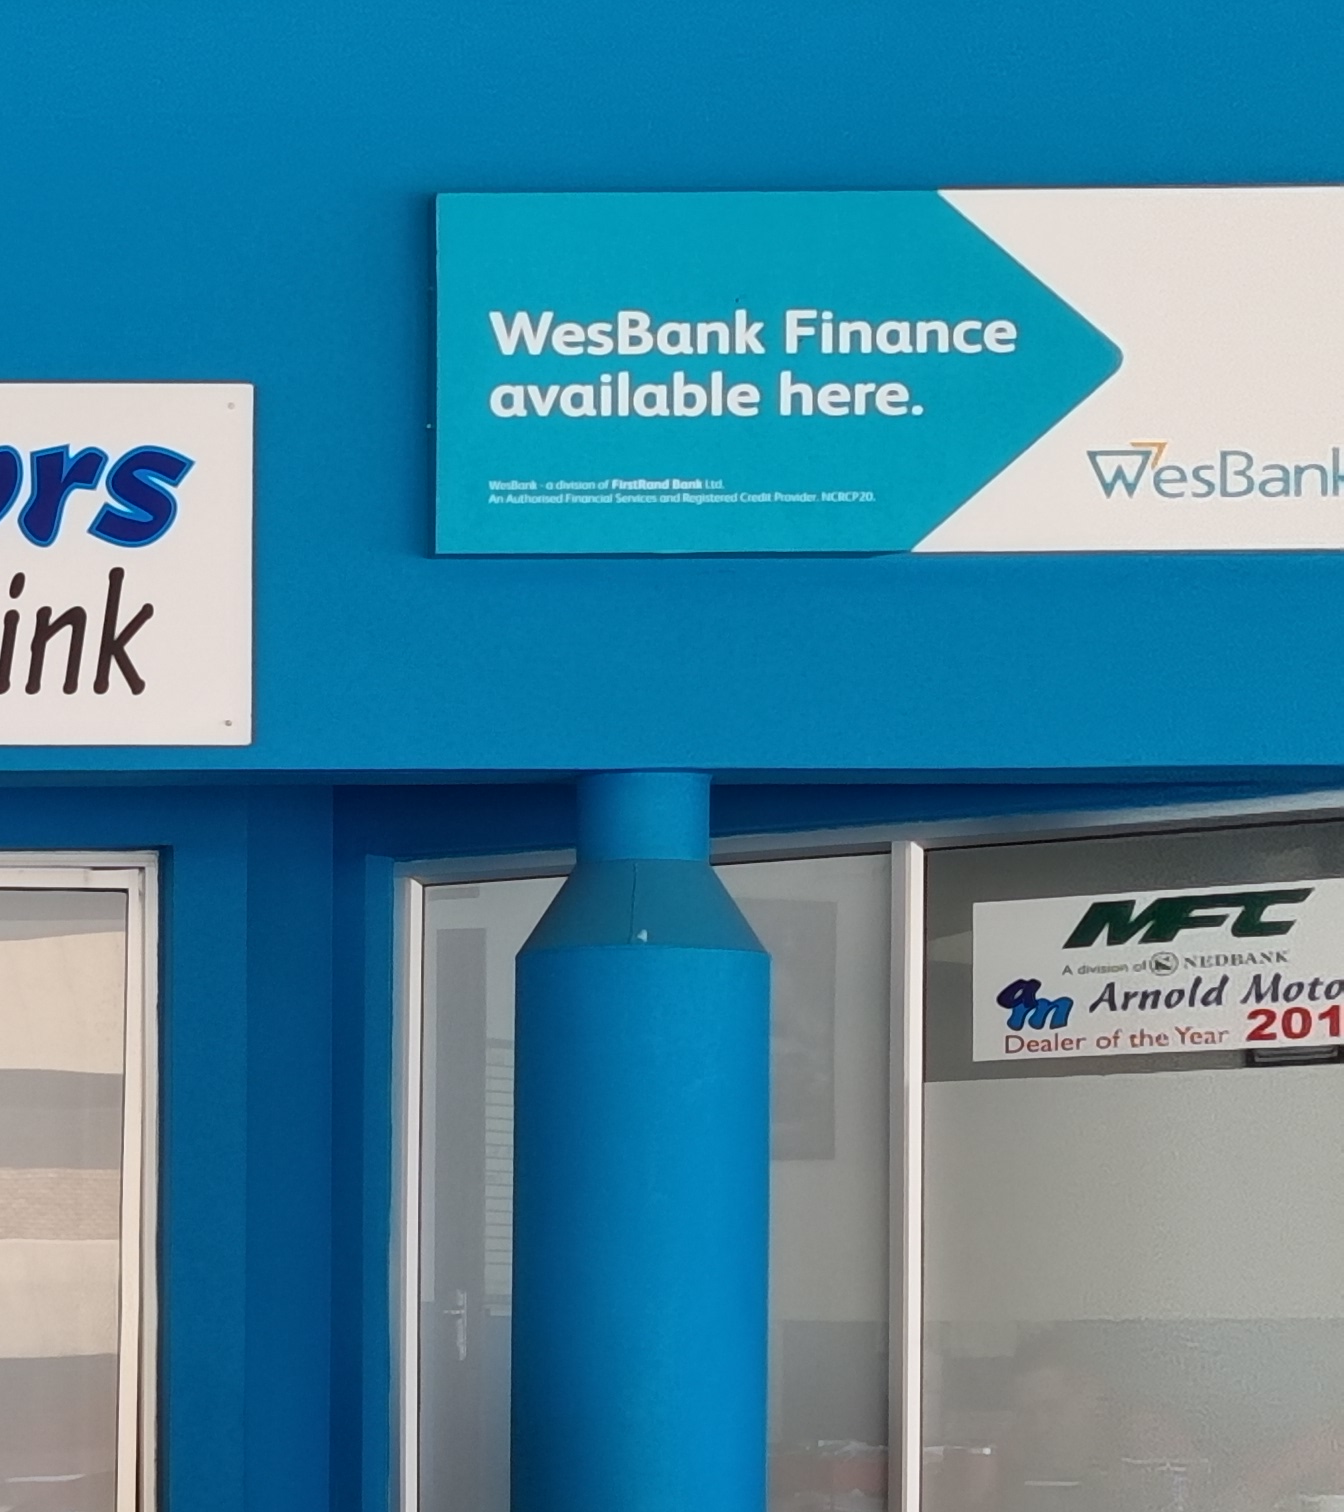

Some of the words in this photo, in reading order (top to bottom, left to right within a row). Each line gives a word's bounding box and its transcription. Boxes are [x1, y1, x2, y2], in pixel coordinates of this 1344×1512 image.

[490, 310, 764, 355] WesBank
[786, 310, 1018, 354] Finance
[490, 371, 760, 417] available
[780, 371, 924, 415] here.
[488, 480, 537, 491] WesBank
[555, 480, 596, 491] division
[597, 480, 610, 491] of
[611, 479, 670, 491] FirstRand
[672, 479, 703, 490] Bank
[488, 494, 504, 504] An
[505, 493, 562, 504] Authorised
[565, 493, 613, 504] Financial
[614, 493, 657, 504] Services
[659, 493, 681, 503] and
[683, 492, 737, 506] Registered
[739, 492, 772, 503] Credit
[1062, 887, 1315, 949] MFC
[1062, 964, 1074, 976] A
[1077, 962, 1129, 976] division
[1132, 959, 1148, 974] of
[1183, 949, 1290, 969] NEDBANK
[1088, 973, 1230, 1014] Arnold
[1004, 1032, 1087, 1054] Dealer
[1095, 1028, 1123, 1049] of
[1129, 1028, 1170, 1048] the
[1174, 1026, 1230, 1045] Year
[1245, 1004, 1341, 1042] 201
